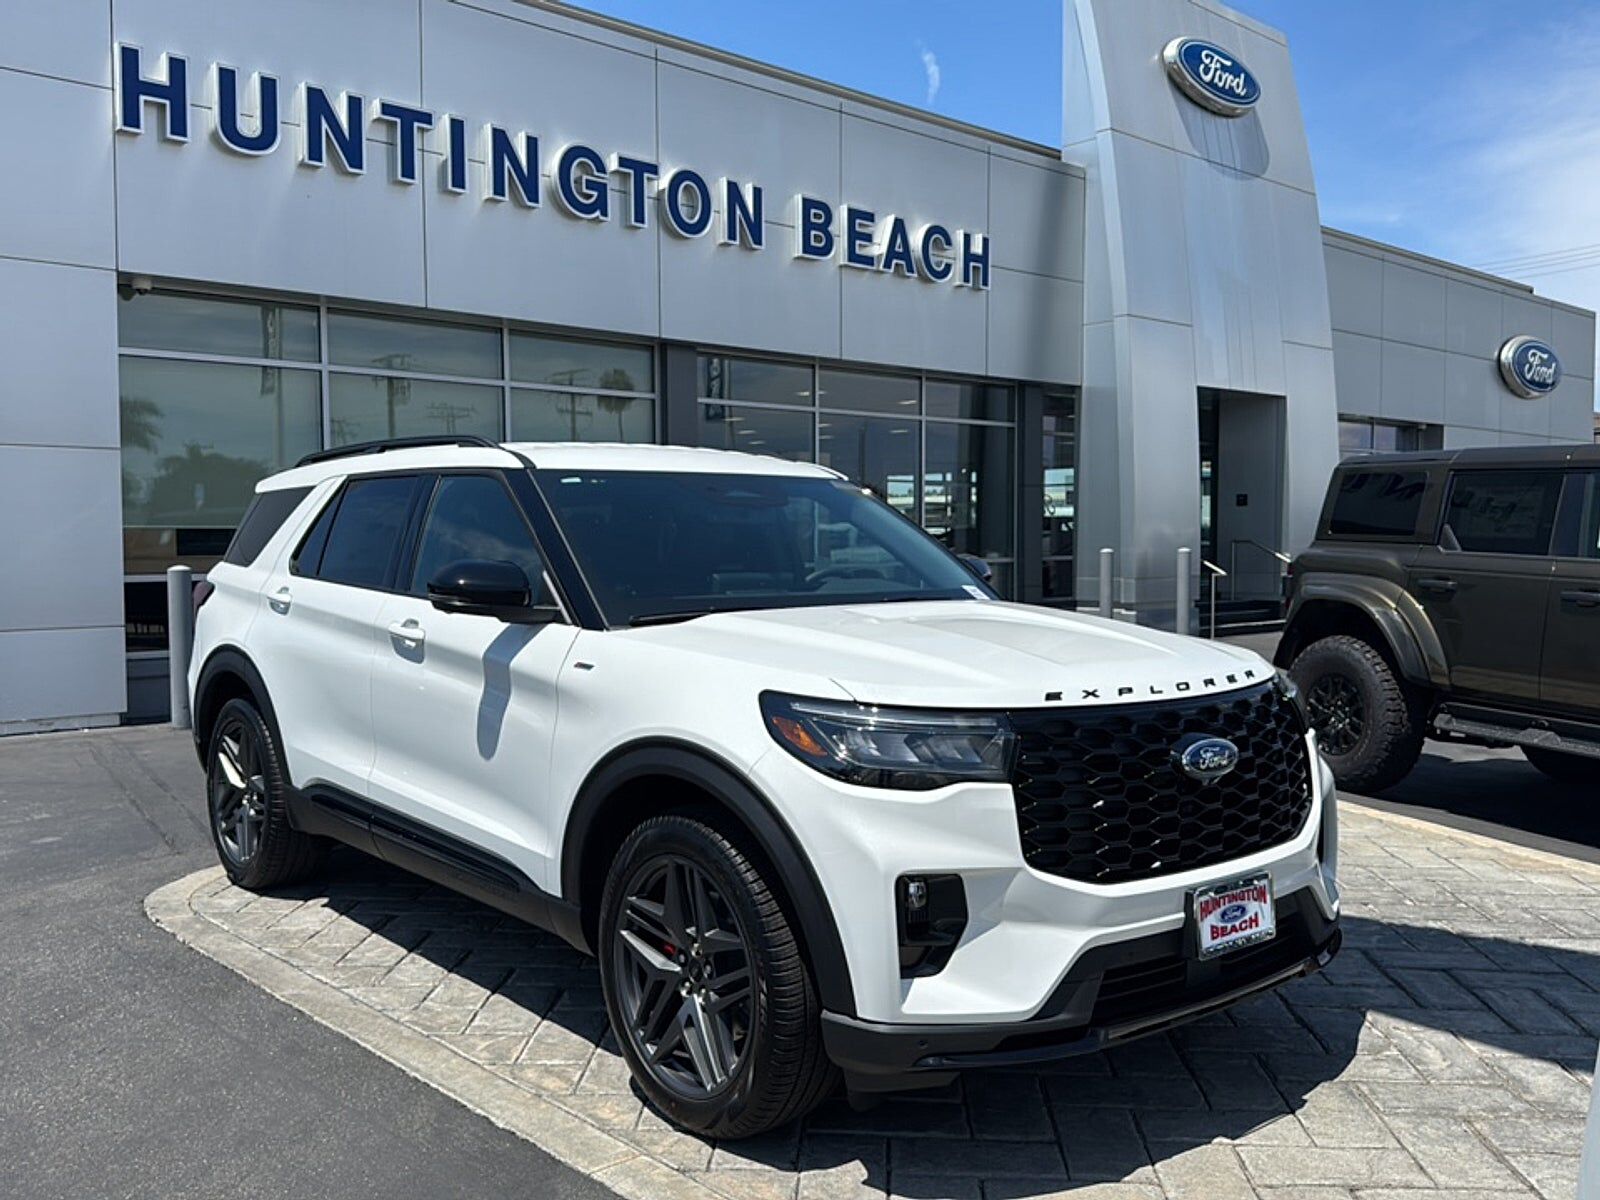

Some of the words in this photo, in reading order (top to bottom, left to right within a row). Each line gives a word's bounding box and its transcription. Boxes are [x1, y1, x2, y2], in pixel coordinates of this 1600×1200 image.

[1199, 50, 1247, 96] Ford
[115, 42, 765, 250] HUNTINGTON
[794, 193, 991, 291] BEACH
[1525, 349, 1556, 383] Ford
[1045, 670, 1255, 701] EXPLORER
[1199, 746, 1229, 769] Ford
[1200, 884, 1267, 922] HUNTINGTON
[1210, 911, 1260, 941] BEACH
